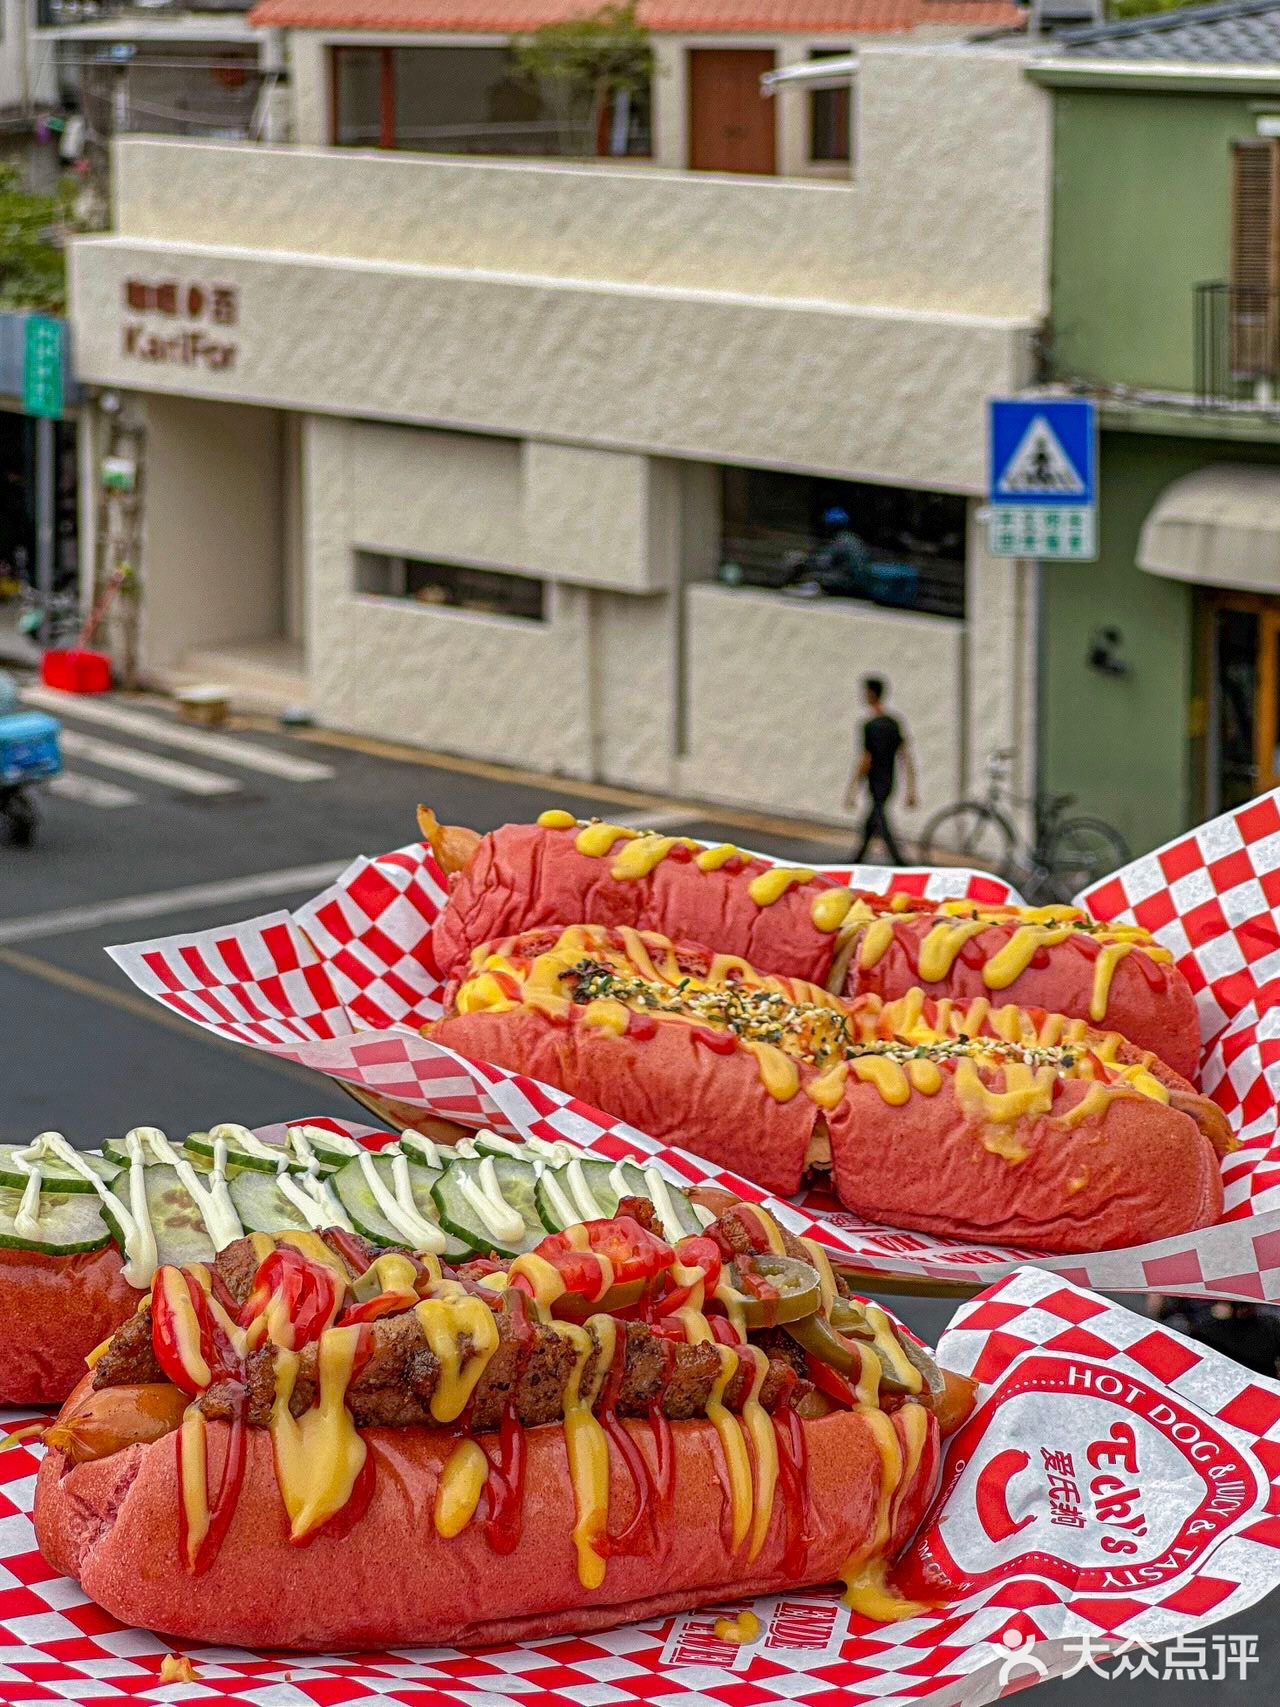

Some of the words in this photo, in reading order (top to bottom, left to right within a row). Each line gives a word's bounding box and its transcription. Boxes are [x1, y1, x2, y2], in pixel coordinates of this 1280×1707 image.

[1068, 1366, 1146, 1404] HOT
[1147, 1403, 1220, 1462] DOG
[1208, 1463, 1236, 1480] &
[1205, 1480, 1245, 1518] JUICY
[1186, 1519, 1216, 1535] &
[1102, 1545, 1198, 1588] TASTY
